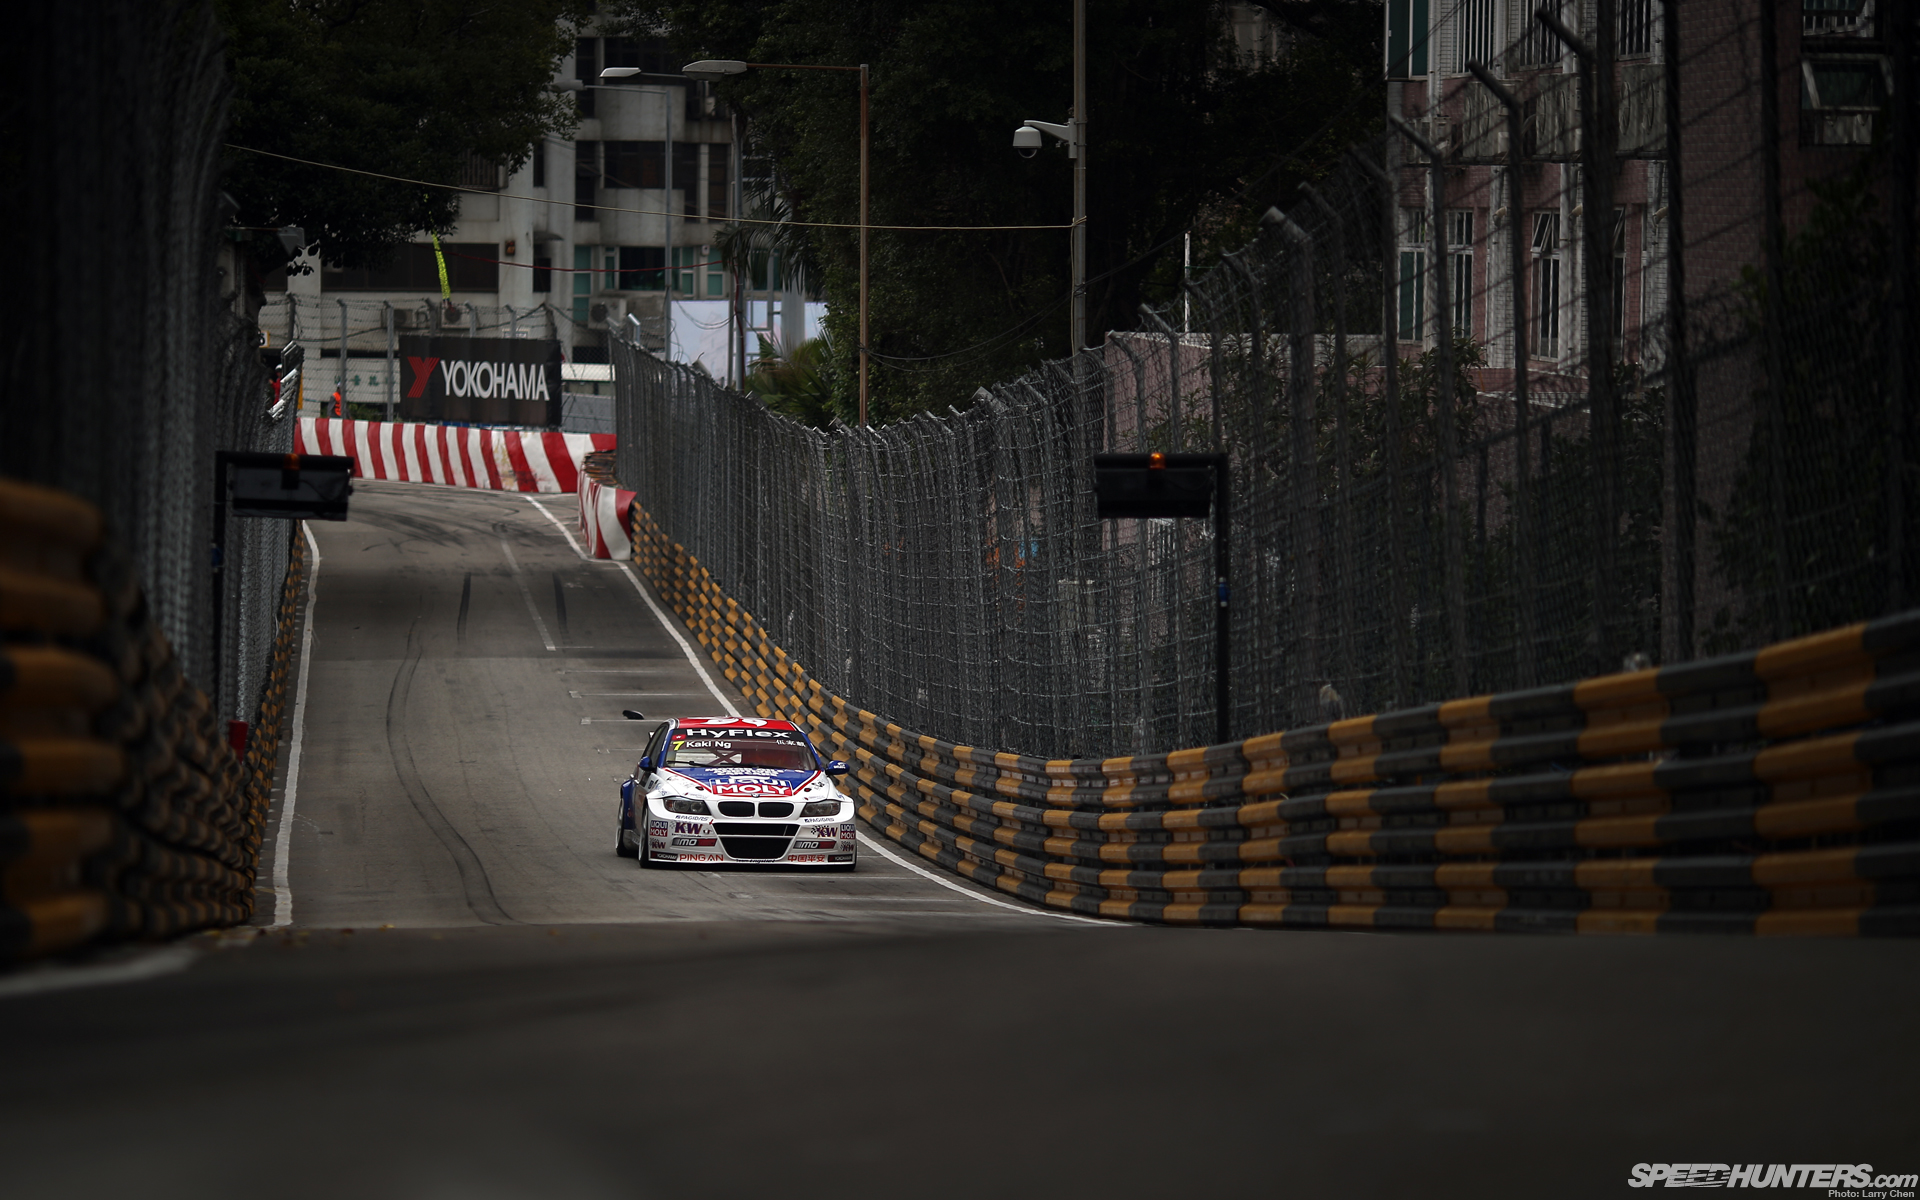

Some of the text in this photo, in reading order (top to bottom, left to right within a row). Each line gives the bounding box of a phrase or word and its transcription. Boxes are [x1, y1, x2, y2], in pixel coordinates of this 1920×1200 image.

[440, 360, 550, 401] YOKOHAMA
[686, 729, 790, 738] HyFlex
[672, 741, 685, 751] 7
[715, 741, 731, 749] Ng
[716, 784, 789, 795] MOLY
[650, 829, 667, 837] MOLY
[675, 822, 703, 834] KW
[817, 827, 838, 837] KW
[788, 854, 825, 862] 中国平安
